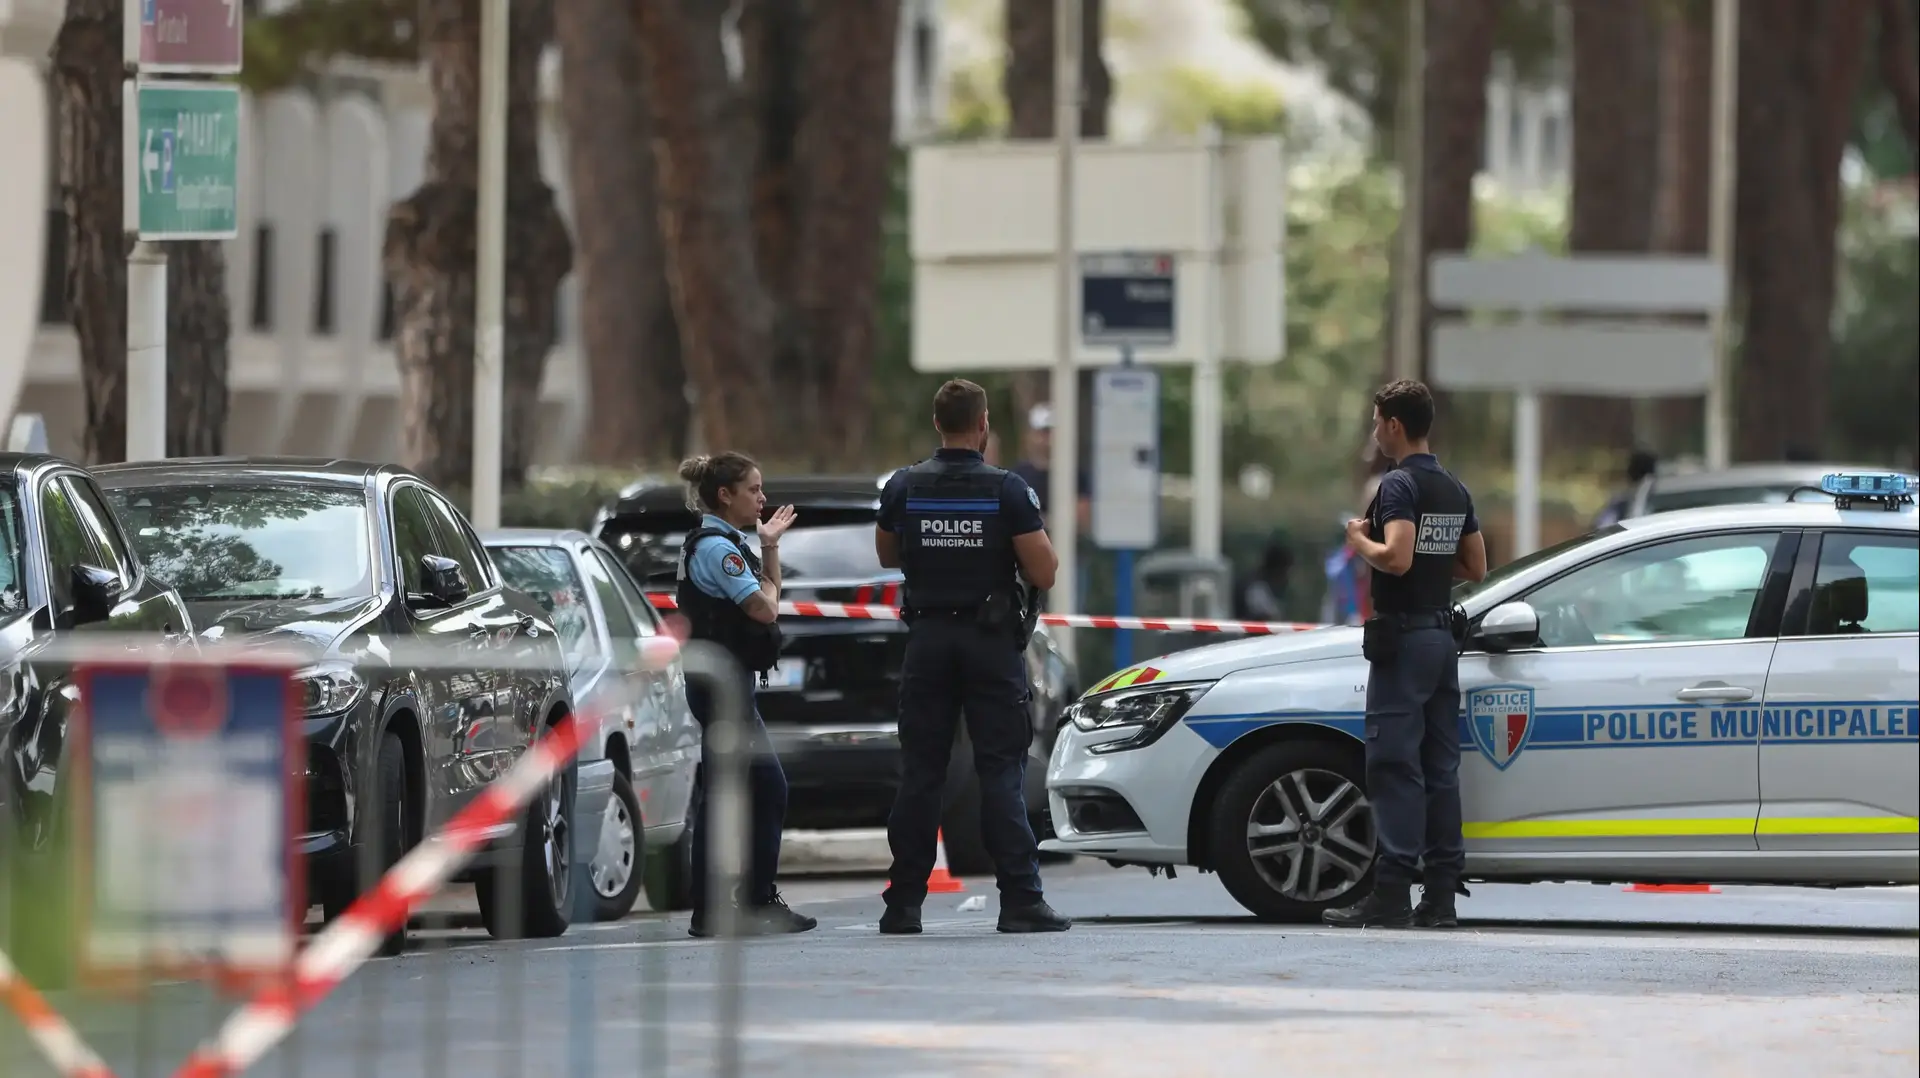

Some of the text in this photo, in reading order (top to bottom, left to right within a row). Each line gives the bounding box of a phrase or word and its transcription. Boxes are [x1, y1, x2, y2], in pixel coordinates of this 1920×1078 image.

[921, 520, 983, 534] POLICE
[922, 538, 984, 547] MUNICIPALE
[1474, 693, 1528, 706] POLICE
[1474, 705, 1528, 713] MUNICIPALE
[1587, 708, 1904, 741] POLICE MUNICIPALE
